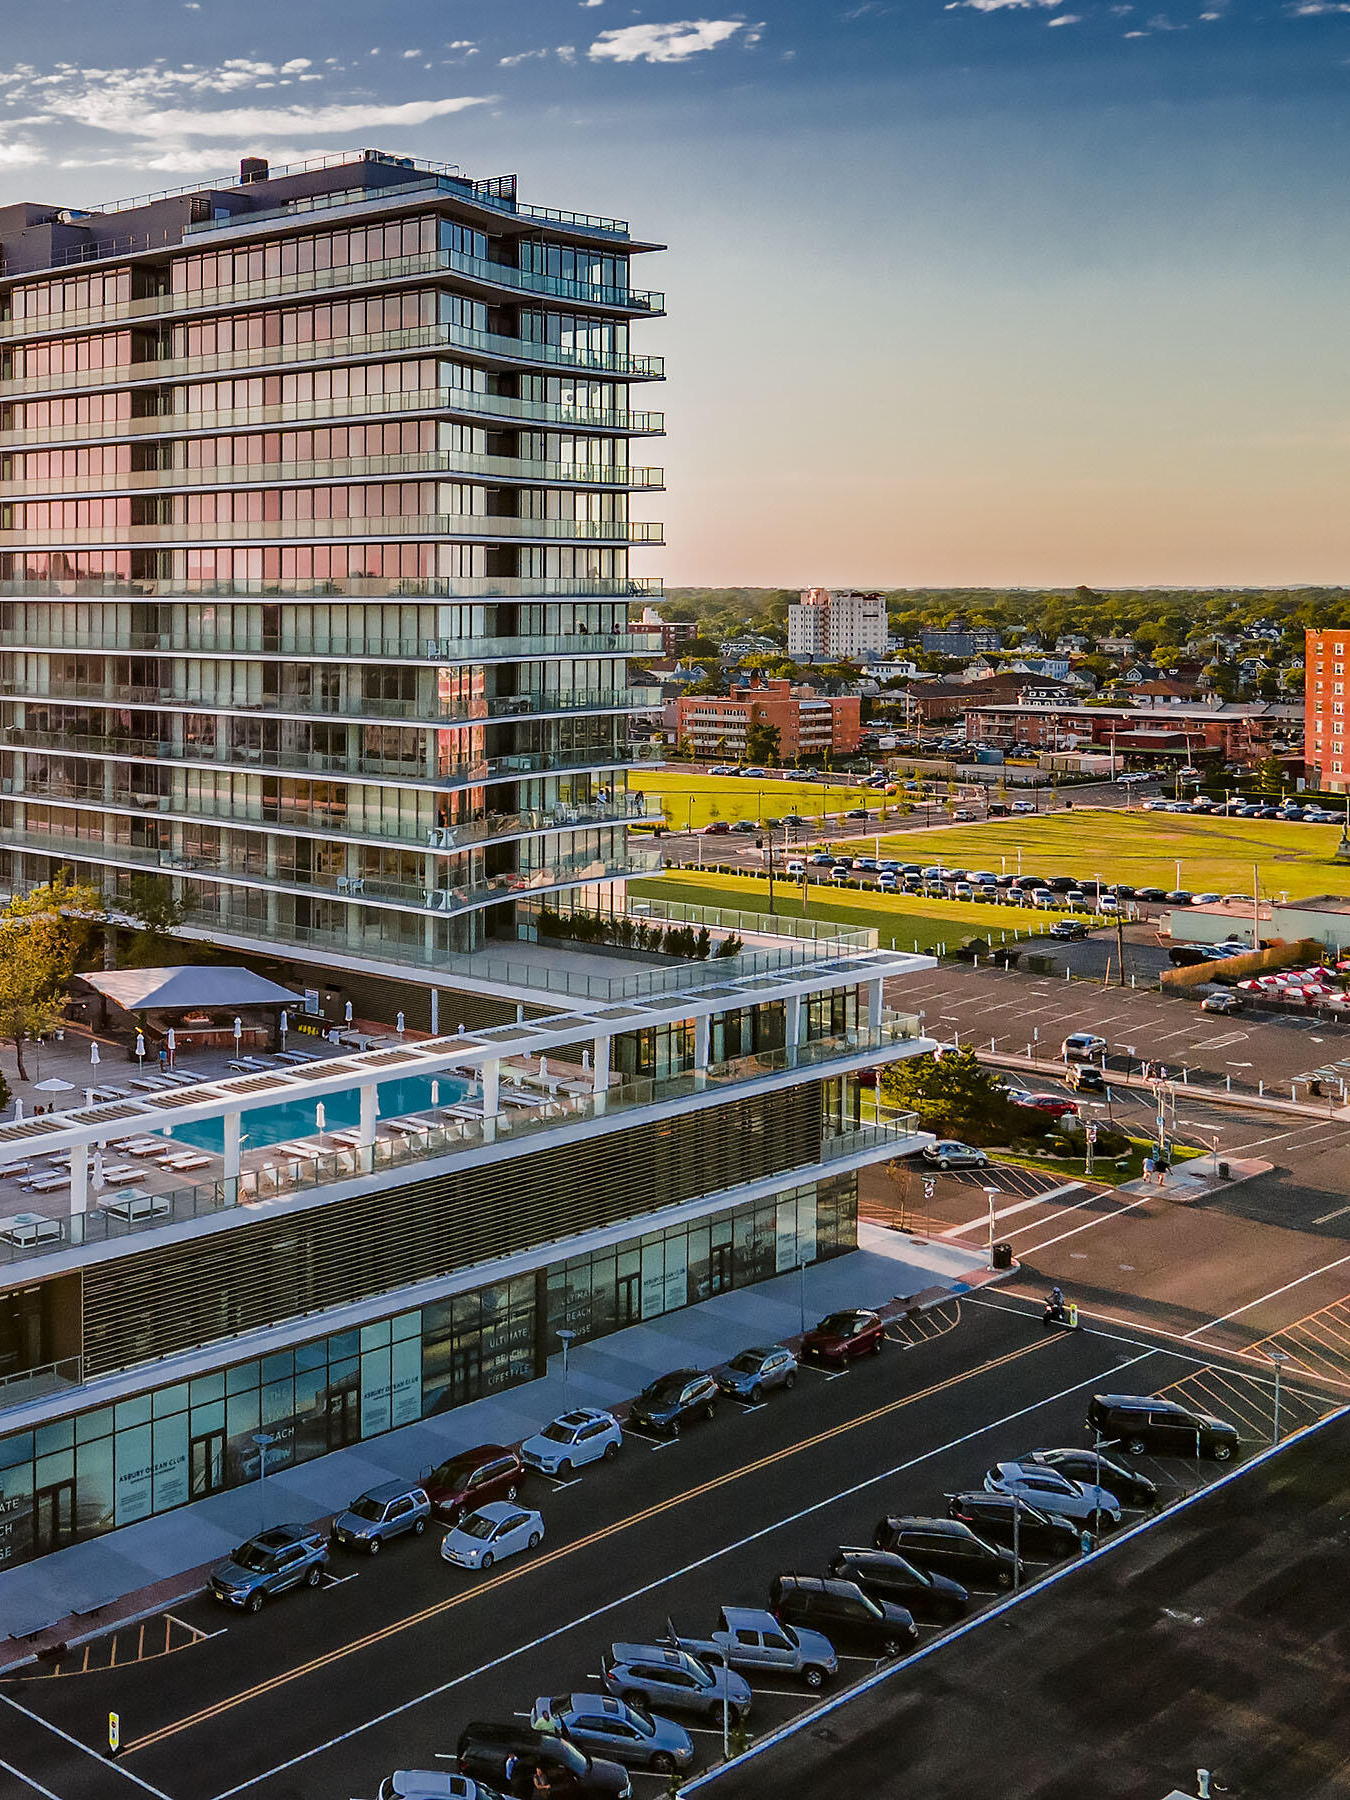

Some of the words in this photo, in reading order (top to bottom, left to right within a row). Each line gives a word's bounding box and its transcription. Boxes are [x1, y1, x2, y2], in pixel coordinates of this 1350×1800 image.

[573, 1323, 591, 1335] OUSE
[269, 1425, 295, 1441] EACH
[145, 1461, 168, 1474] OEAN
